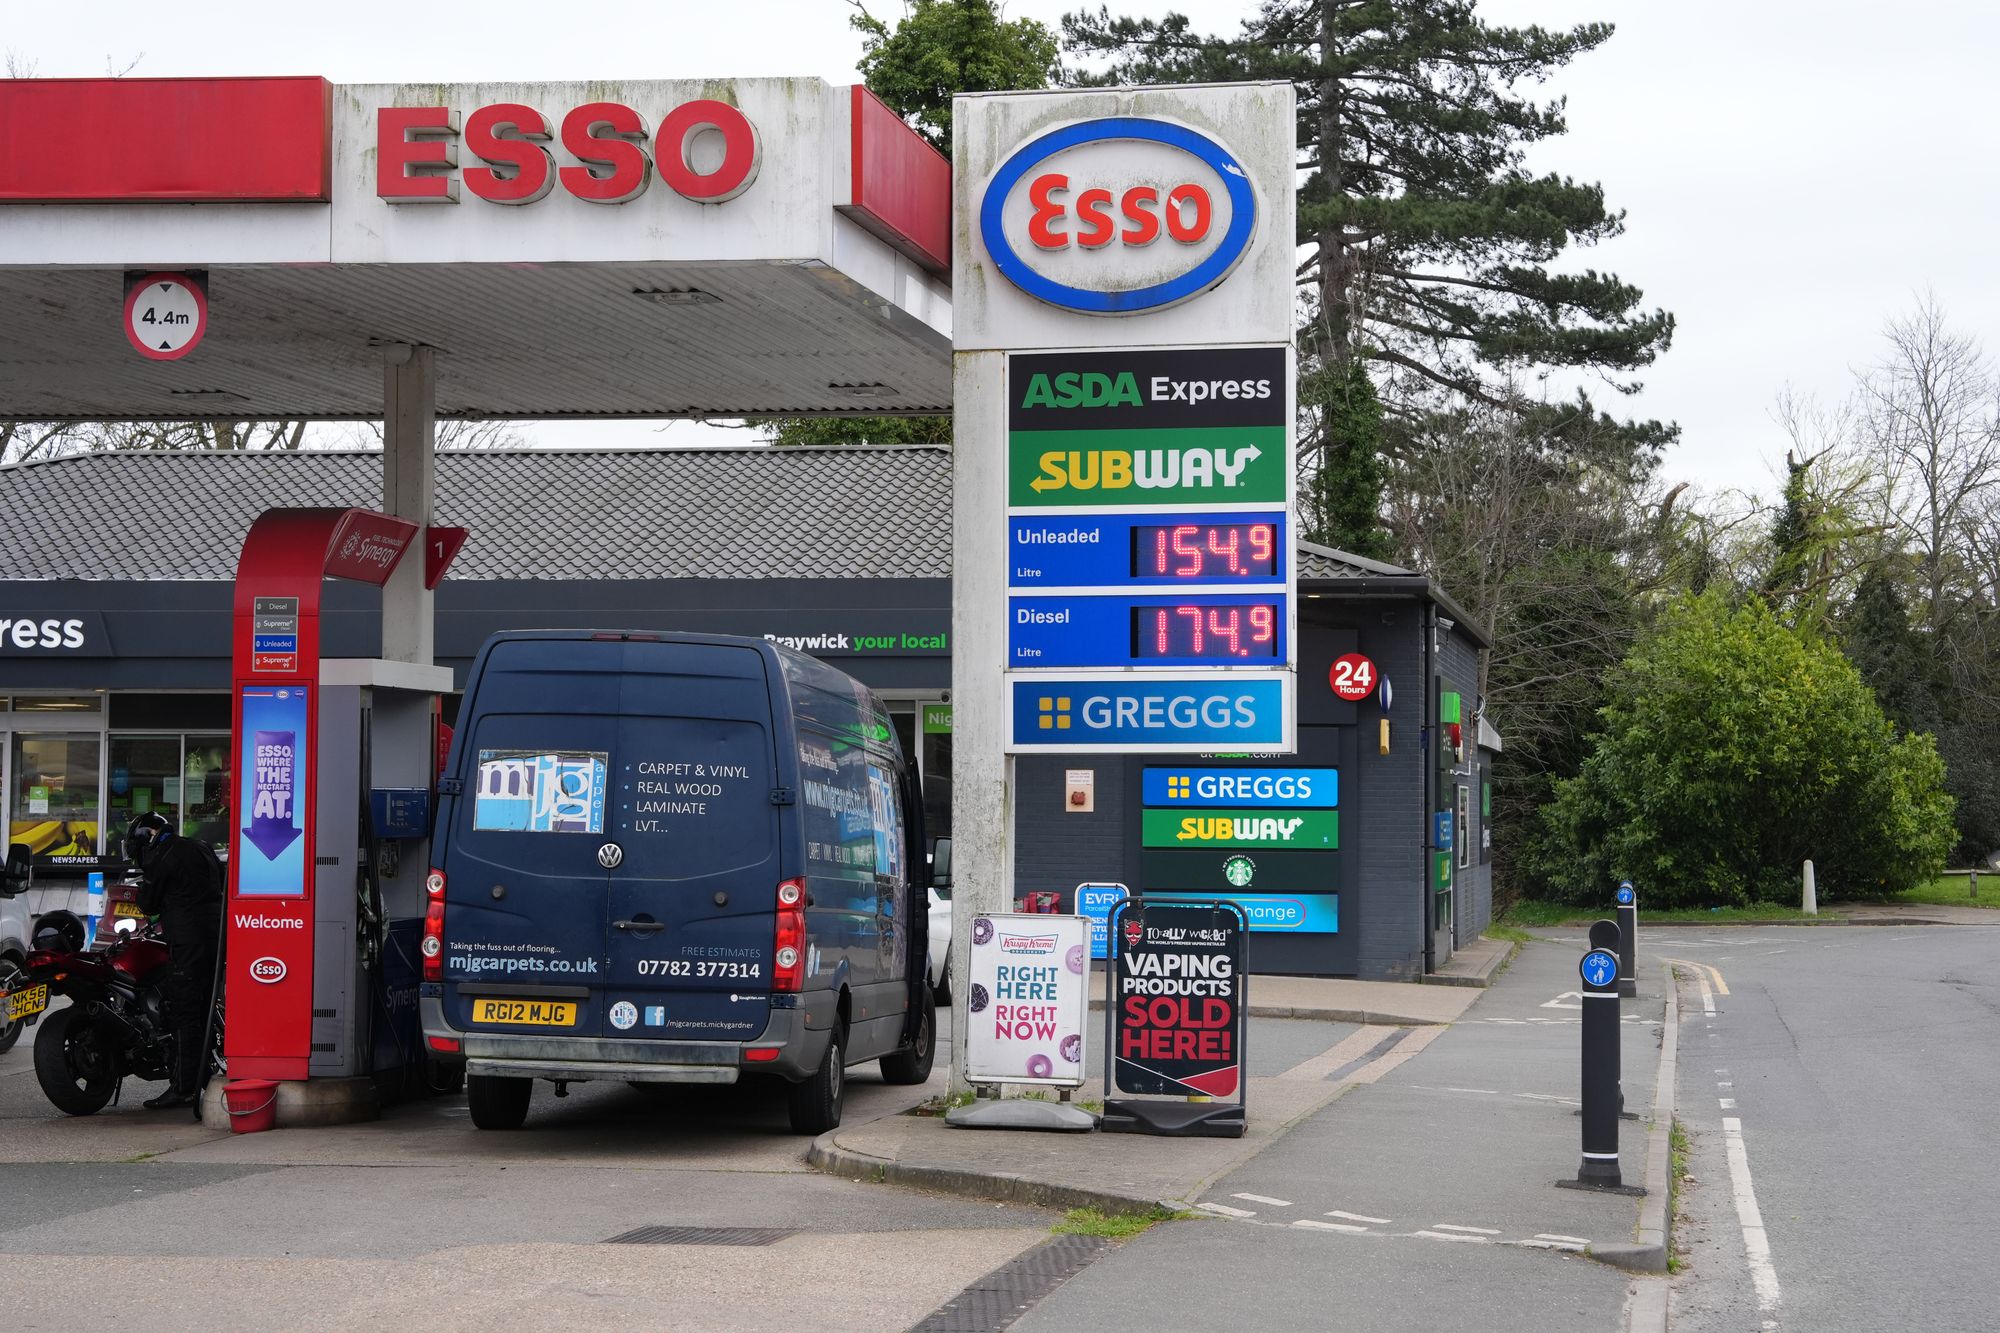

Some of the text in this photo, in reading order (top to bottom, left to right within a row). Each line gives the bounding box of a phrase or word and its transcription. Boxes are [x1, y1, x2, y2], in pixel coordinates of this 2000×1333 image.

[377, 100, 761, 204] ESSO
[142, 306, 189, 326] 4.4m
[1022, 372, 1271, 408] ASDA Express
[1030, 444, 1262, 494] SUBWAY
[1018, 528, 1100, 544] Unleaded
[356, 538, 398, 568] Synergy
[434, 541, 443, 558] 1
[1157, 525, 1272, 576] 154.9
[1018, 567, 1041, 577] Litre
[1018, 609, 1070, 624] Diesel
[0, 619, 84, 648] ress
[1157, 606, 1272, 656] 174.9
[263, 640, 292, 648] Unleaded
[854, 635, 897, 652] your
[902, 633, 946, 649] local
[1018, 647, 1041, 657] Litre
[1335, 661, 1371, 686] 24
[1340, 686, 1366, 694] Hours
[1082, 695, 1256, 729] GREGGS
[257, 745, 293, 758] ESSO.
[257, 758, 291, 766] WHERE
[638, 762, 749, 778] CARPET & VINYL
[257, 767, 291, 783] THE
[637, 782, 721, 796] REAL WOOD
[1197, 776, 1312, 799] GREGGS
[254, 790, 292, 819] AT.
[636, 801, 706, 815] LAMINATE
[635, 820, 668, 833] LVT...
[1176, 817, 1304, 841] SUBWAY
[52, 856, 99, 864] NEWSPAPERS
[235, 914, 304, 929] Welcome
[450, 942, 473, 951] Taking
[474, 943, 485, 951] the
[487, 943, 501, 951] fuss
[517, 944, 525, 952] of
[526, 944, 561, 954] flooring...
[681, 946, 760, 958] FREE ESTIMATES
[1003, 938, 1054, 949] Krispy Kreme
[450, 954, 598, 973] mjgcarpets.co.uk
[638, 960, 760, 978] 07782 377314
[1124, 953, 1232, 978] VAPING
[997, 966, 1058, 982] RIGHT
[12, 986, 45, 1005] NK56
[996, 983, 1057, 1000] HERE
[1123, 978, 1231, 997] PRODUCTS
[15, 999, 40, 1015] HCN
[484, 1002, 566, 1023] RG12 MJG
[996, 1005, 1057, 1021] RIGHT
[1124, 996, 1231, 1029] SOLD
[995, 1022, 1057, 1041] NOW
[1122, 1028, 1231, 1060] HERE!
